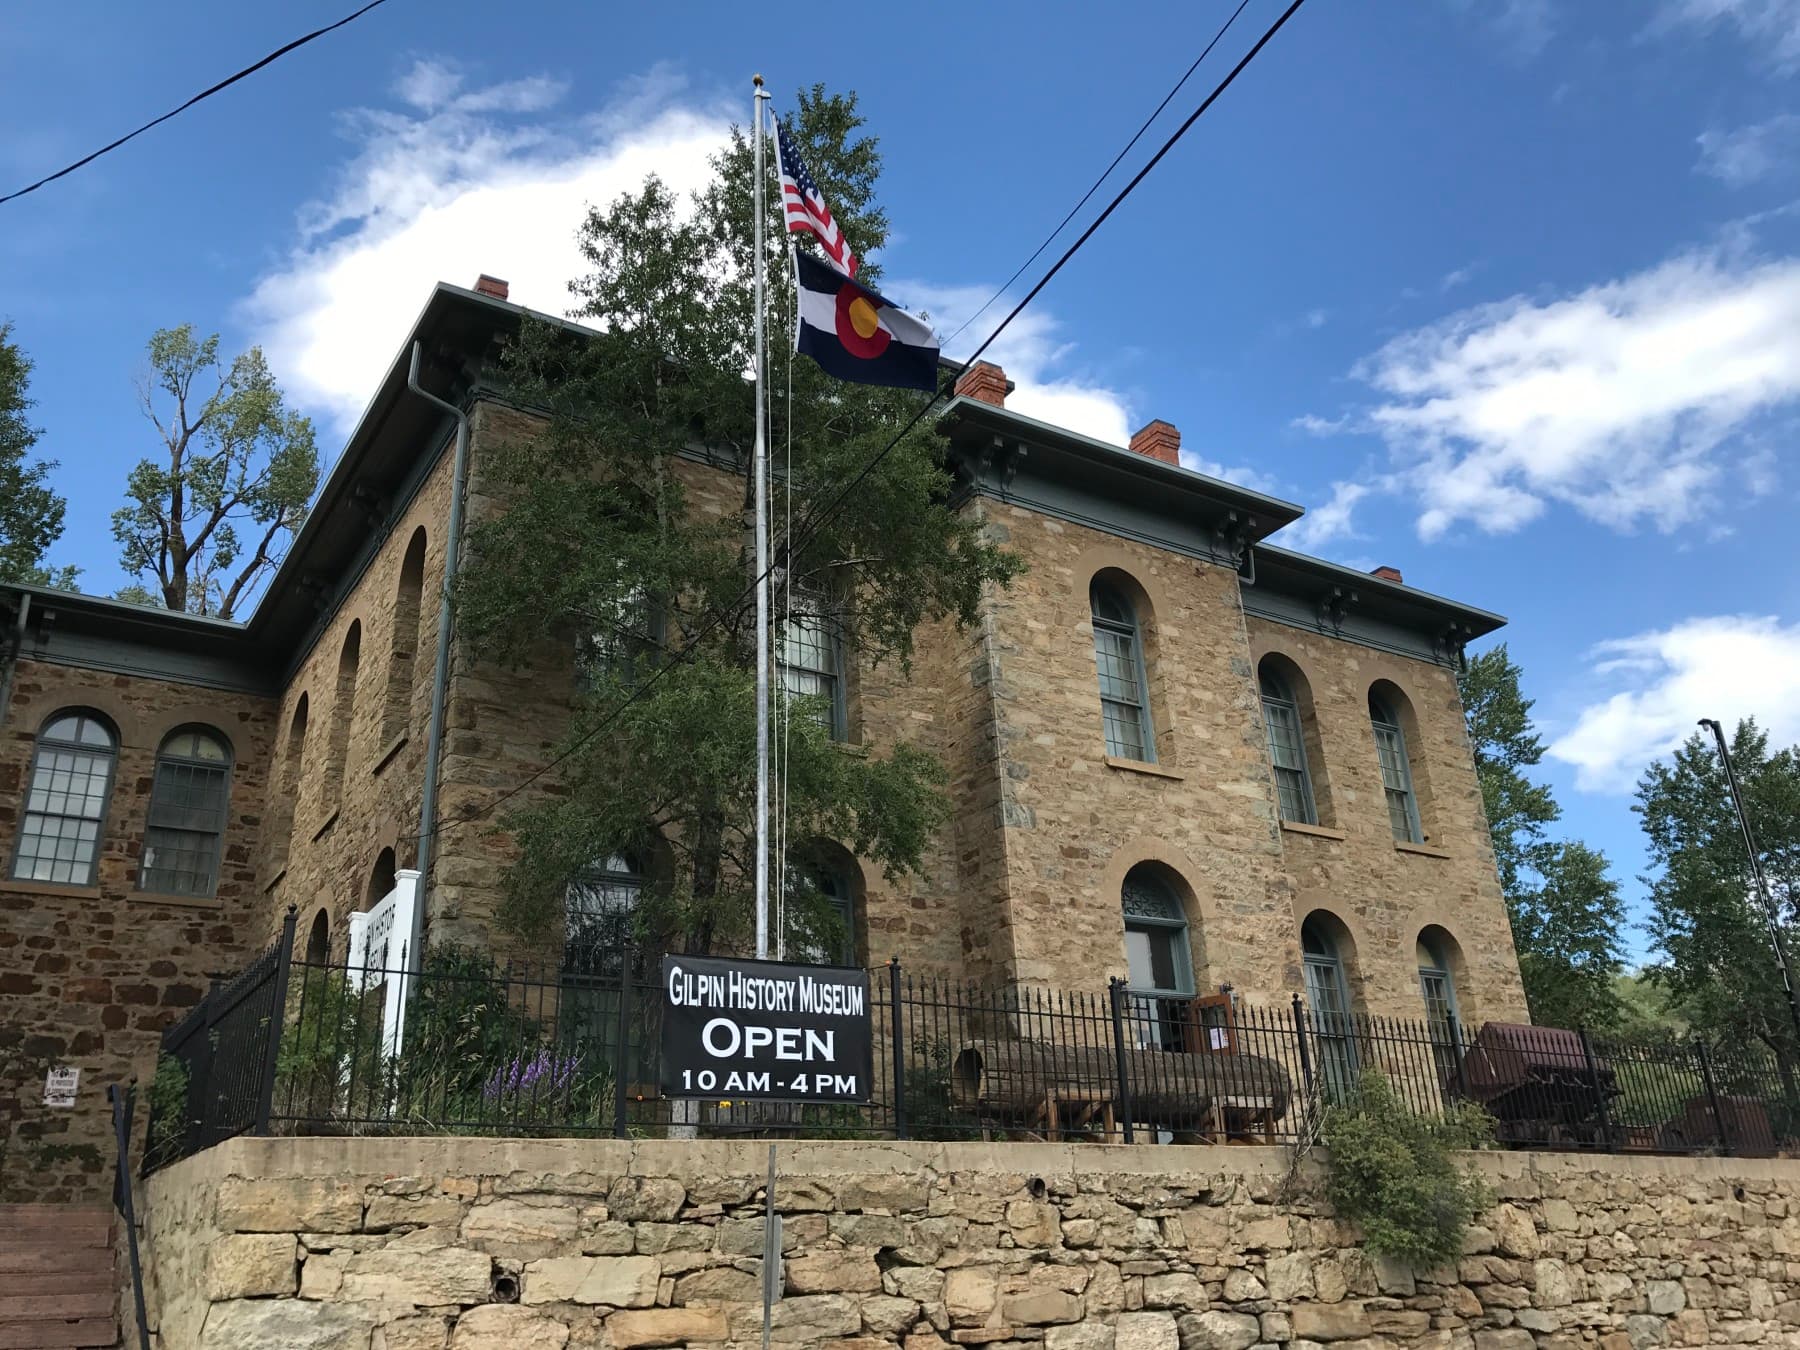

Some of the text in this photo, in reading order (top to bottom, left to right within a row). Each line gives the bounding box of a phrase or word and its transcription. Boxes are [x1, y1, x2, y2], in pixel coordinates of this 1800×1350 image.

[669, 966, 864, 1016] GILPIN HISTORY MUSEUM
[702, 1017, 836, 1061] OPEN
[682, 1069, 717, 1091] 10
[724, 1071, 770, 1092] AM
[790, 1073, 809, 1093] 4
[815, 1074, 857, 1095] PM
